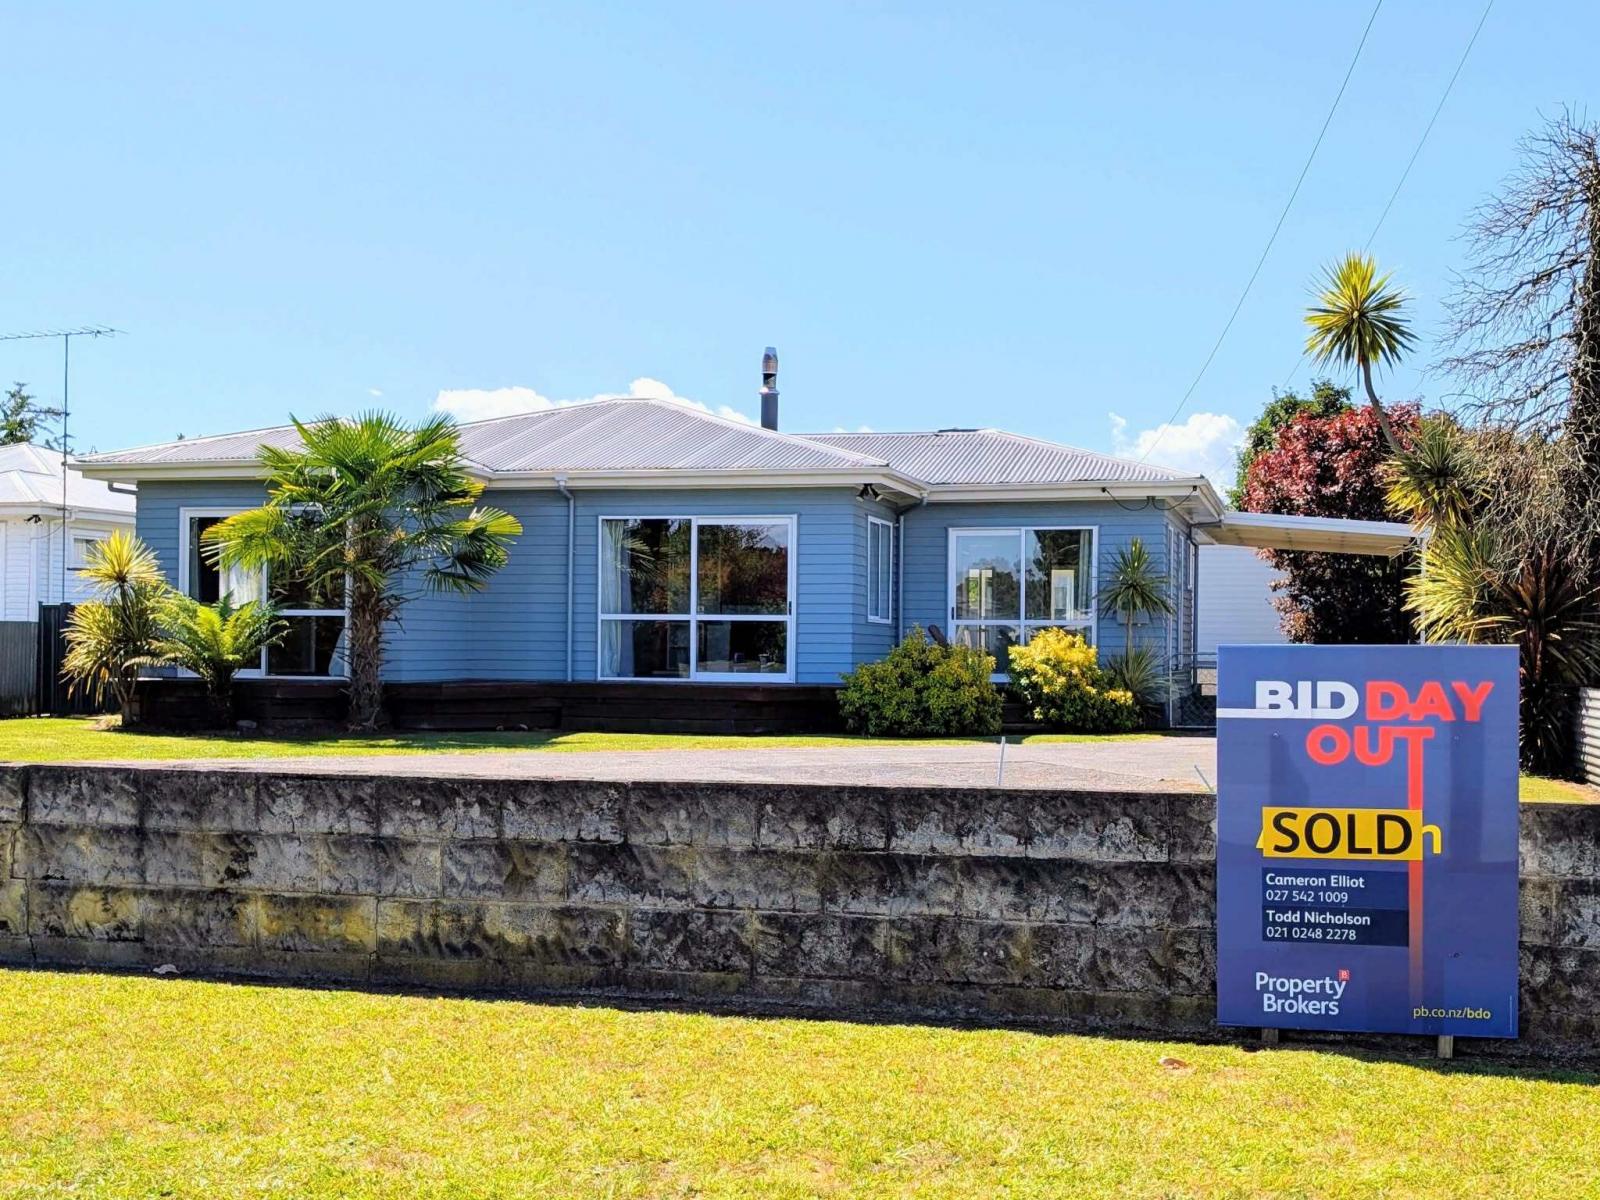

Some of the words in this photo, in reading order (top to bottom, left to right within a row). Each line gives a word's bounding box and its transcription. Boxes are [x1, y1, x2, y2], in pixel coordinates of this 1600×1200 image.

[1255, 680, 1359, 719] BID
[1366, 681, 1494, 721] DAY
[1272, 812, 1413, 855] SOLD
[1265, 873, 1326, 887] Cameron
[1330, 875, 1365, 888] Elliot
[1265, 890, 1289, 901] 027
[1292, 890, 1315, 902] 542
[1318, 891, 1348, 903] 1009
[1265, 910, 1301, 923] Todd
[1304, 911, 1371, 926] Nicholson
[1266, 926, 1288, 938] 021
[1291, 927, 1323, 939] 0248
[1326, 928, 1357, 941] 2278
[1255, 971, 1347, 999] Property
[1263, 993, 1340, 1016] Brokers
[1413, 1005, 1491, 1019] pb.co.nz/bdo
